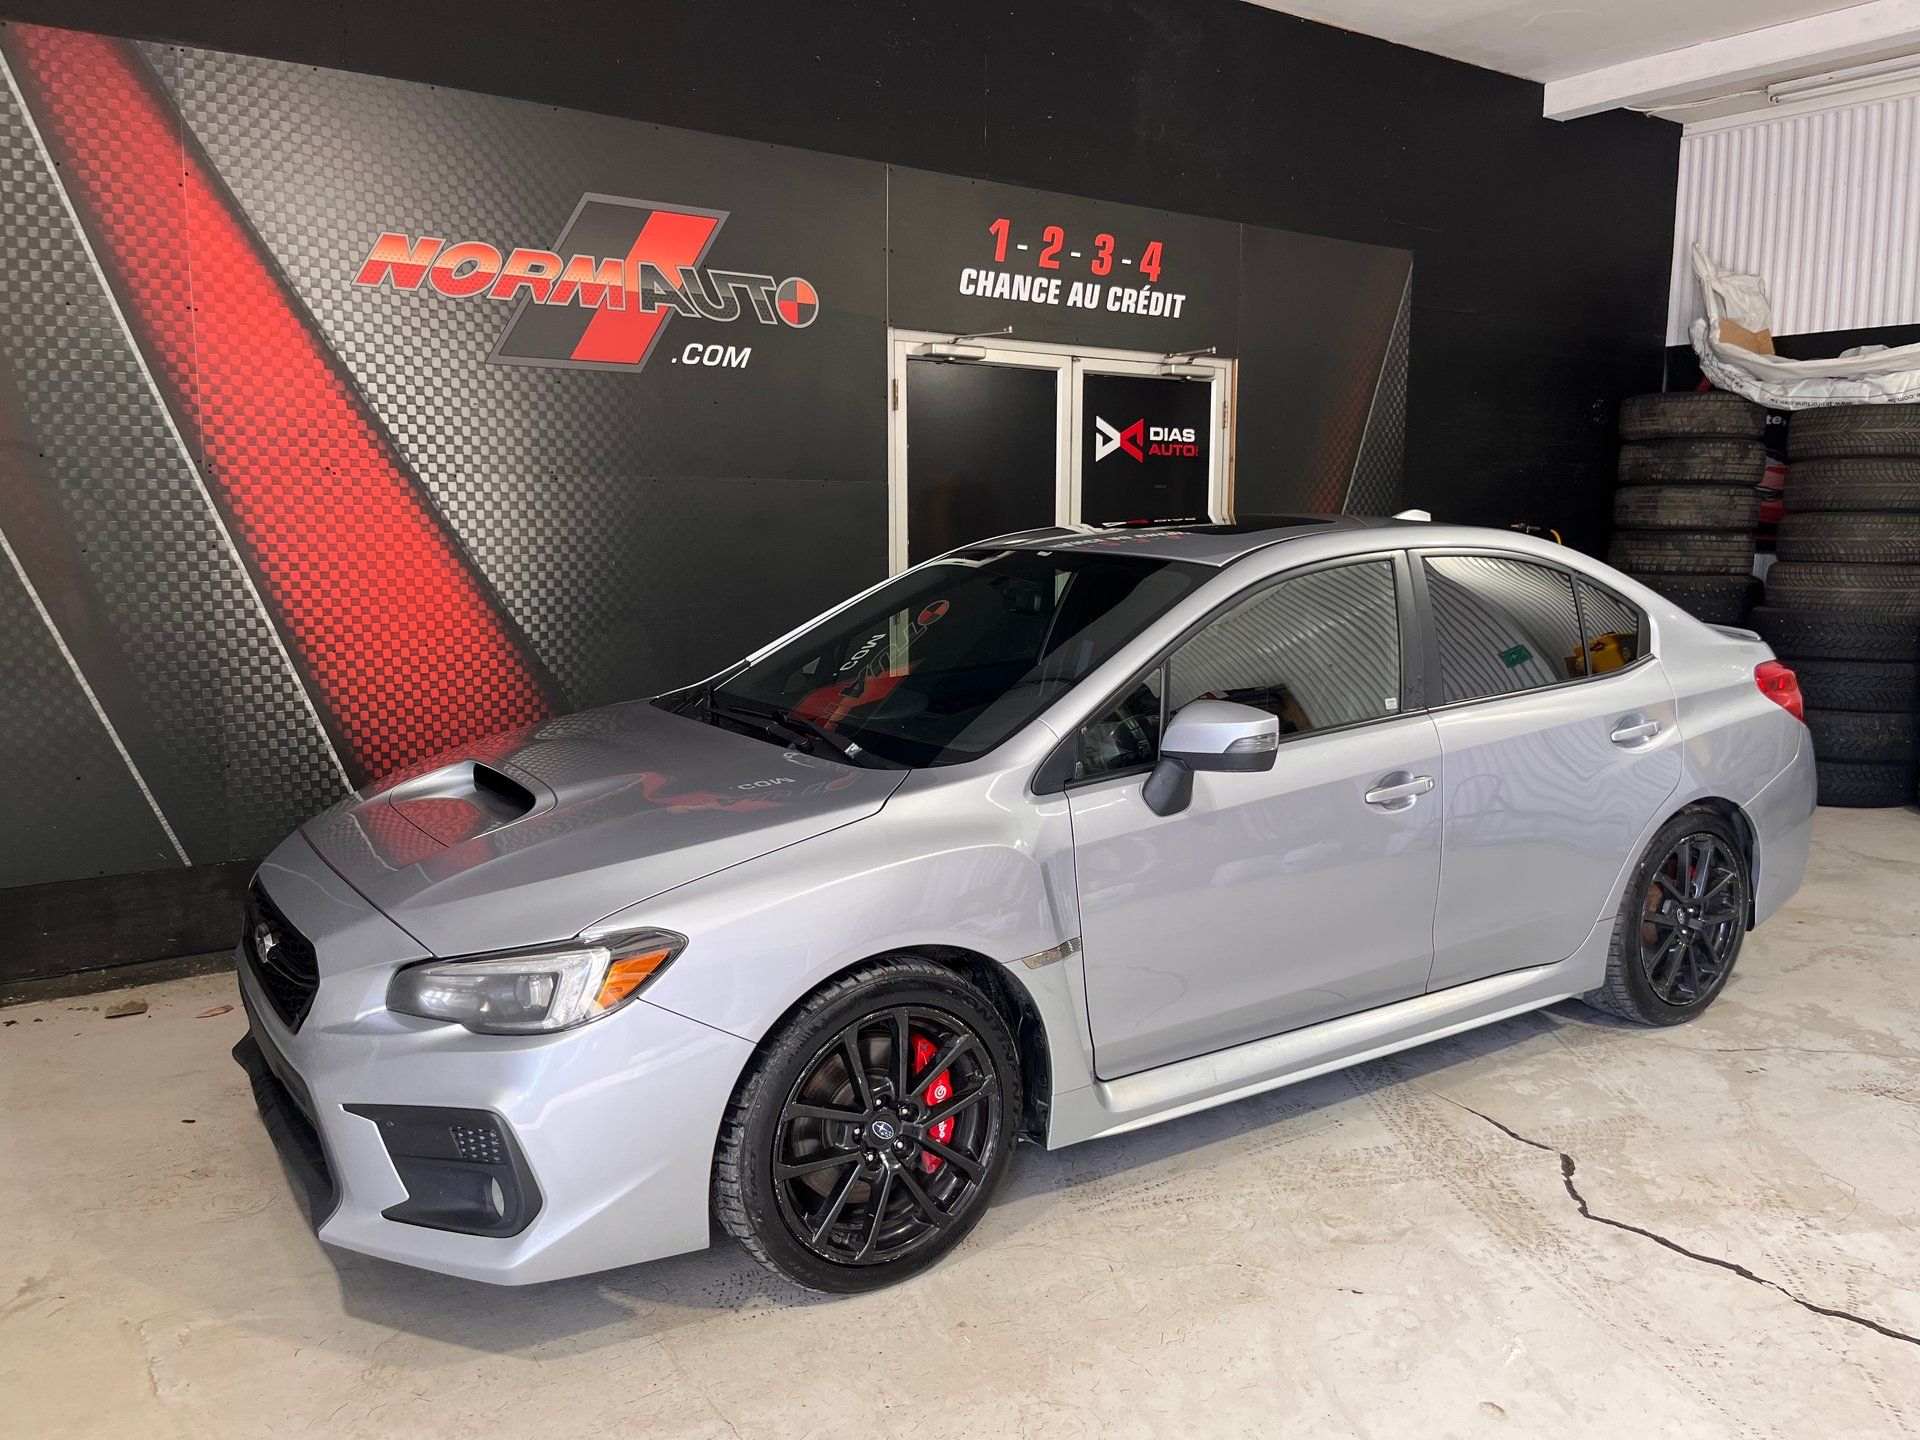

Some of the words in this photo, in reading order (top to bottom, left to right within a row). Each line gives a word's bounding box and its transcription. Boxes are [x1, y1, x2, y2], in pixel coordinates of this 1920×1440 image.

[959, 267, 1061, 305] CHANCE
[1066, 281, 1100, 310] AU
[1106, 285, 1186, 319] CRÉDIT
[671, 342, 752, 369] .COM
[1149, 427, 1196, 442] DIAS
[1148, 443, 1196, 457] AUTO
